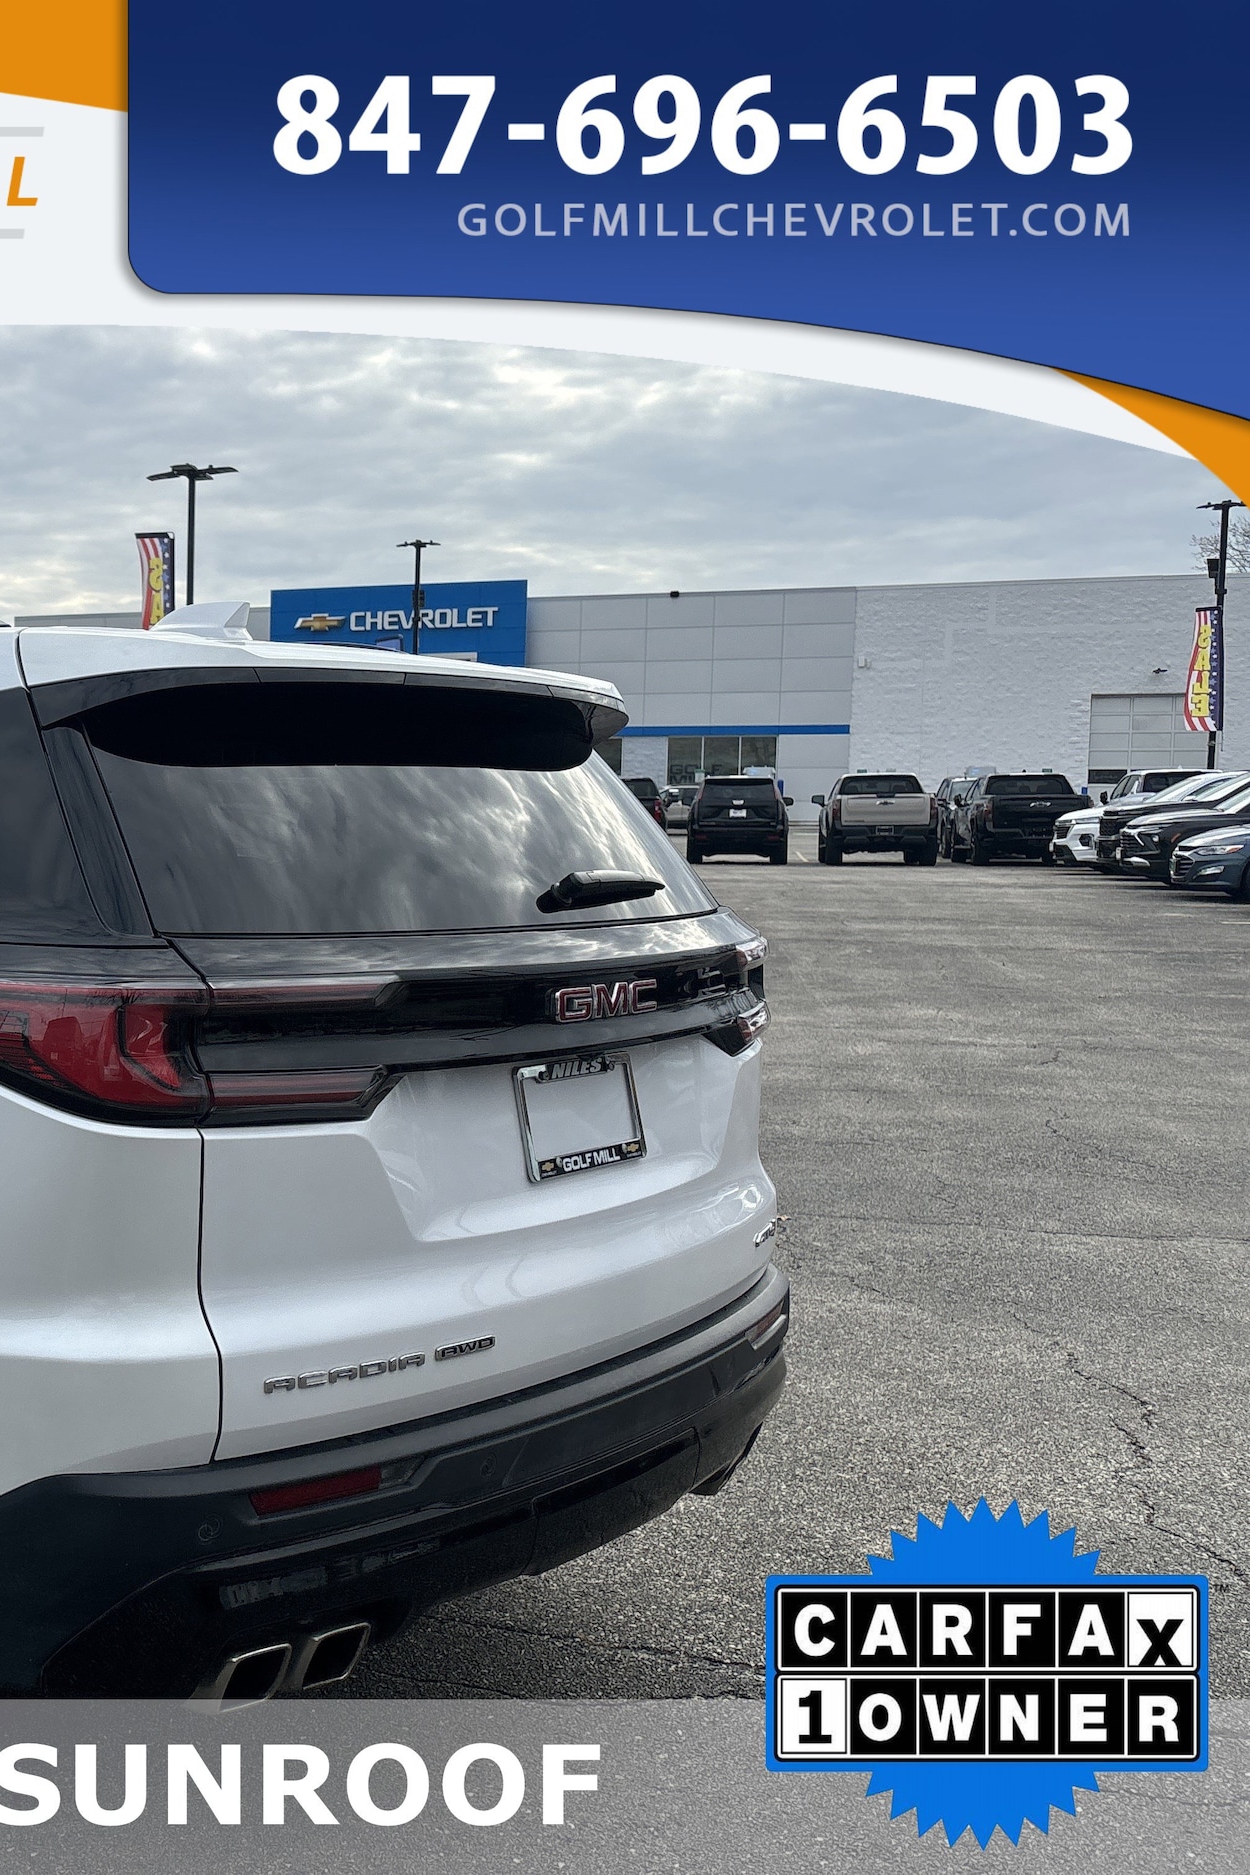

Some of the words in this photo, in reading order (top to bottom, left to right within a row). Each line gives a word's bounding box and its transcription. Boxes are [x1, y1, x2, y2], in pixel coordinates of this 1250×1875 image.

[349, 606, 499, 632] CHEVROLET
[555, 979, 658, 1024] GMC
[551, 1057, 603, 1080] NILES
[562, 1153, 592, 1173] GOLF
[593, 1147, 621, 1166] MILL
[263, 1351, 427, 1395] ACADIA
[434, 1334, 496, 1362] AWD
